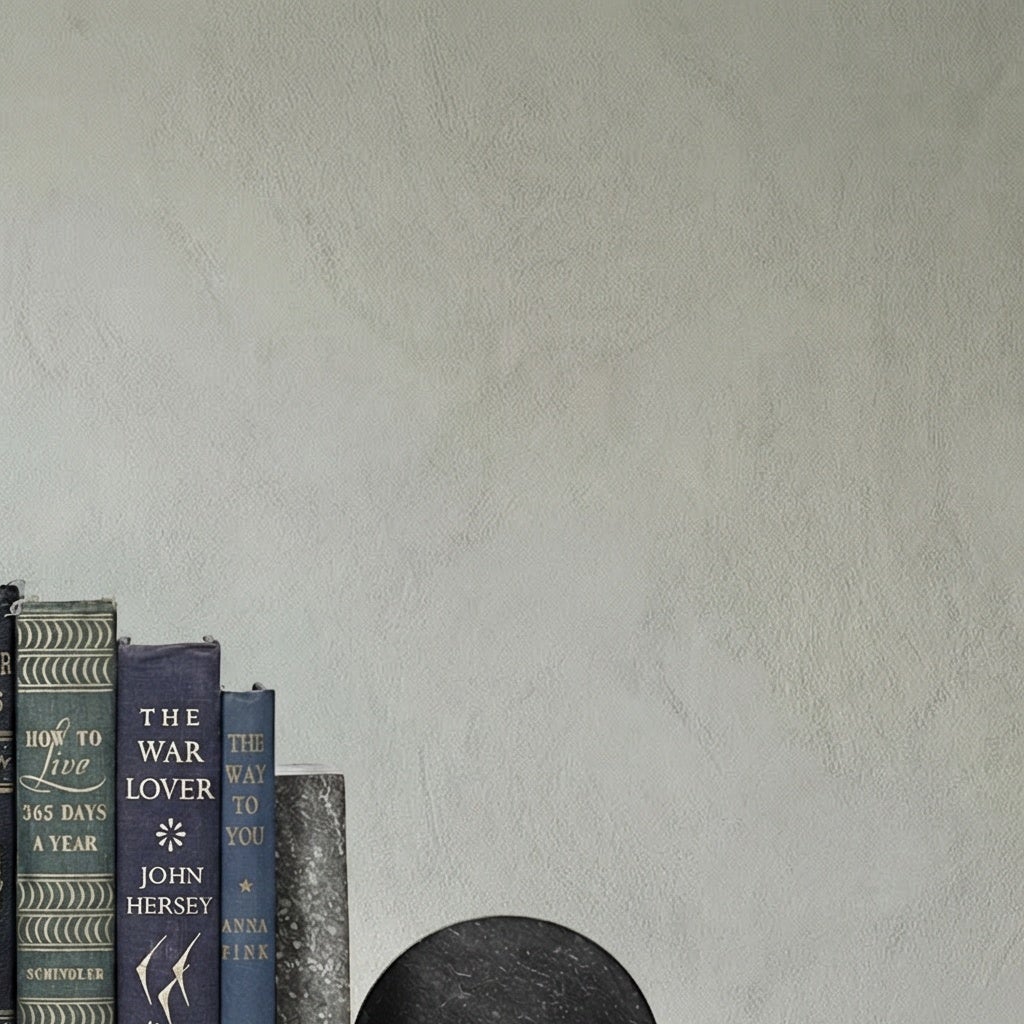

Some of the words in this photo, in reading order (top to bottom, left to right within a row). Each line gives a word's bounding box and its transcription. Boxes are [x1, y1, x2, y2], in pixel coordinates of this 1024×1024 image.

[139, 708, 200, 727] THE
[25, 730, 63, 748] HOW
[76, 729, 103, 747] TO
[228, 733, 265, 753] THE
[137, 740, 205, 763] WAR
[226, 764, 267, 784] WAY
[126, 777, 215, 800] LOVER
[22, 804, 54, 821] 365
[61, 803, 107, 821] DAYS
[232, 795, 260, 815] TO
[33, 835, 44, 852] A
[48, 835, 98, 852] YEAR
[226, 826, 265, 846] YOU
[139, 866, 204, 889] JOHN
[126, 896, 213, 915] HERSEY
[222, 918, 269, 933] ANNA
